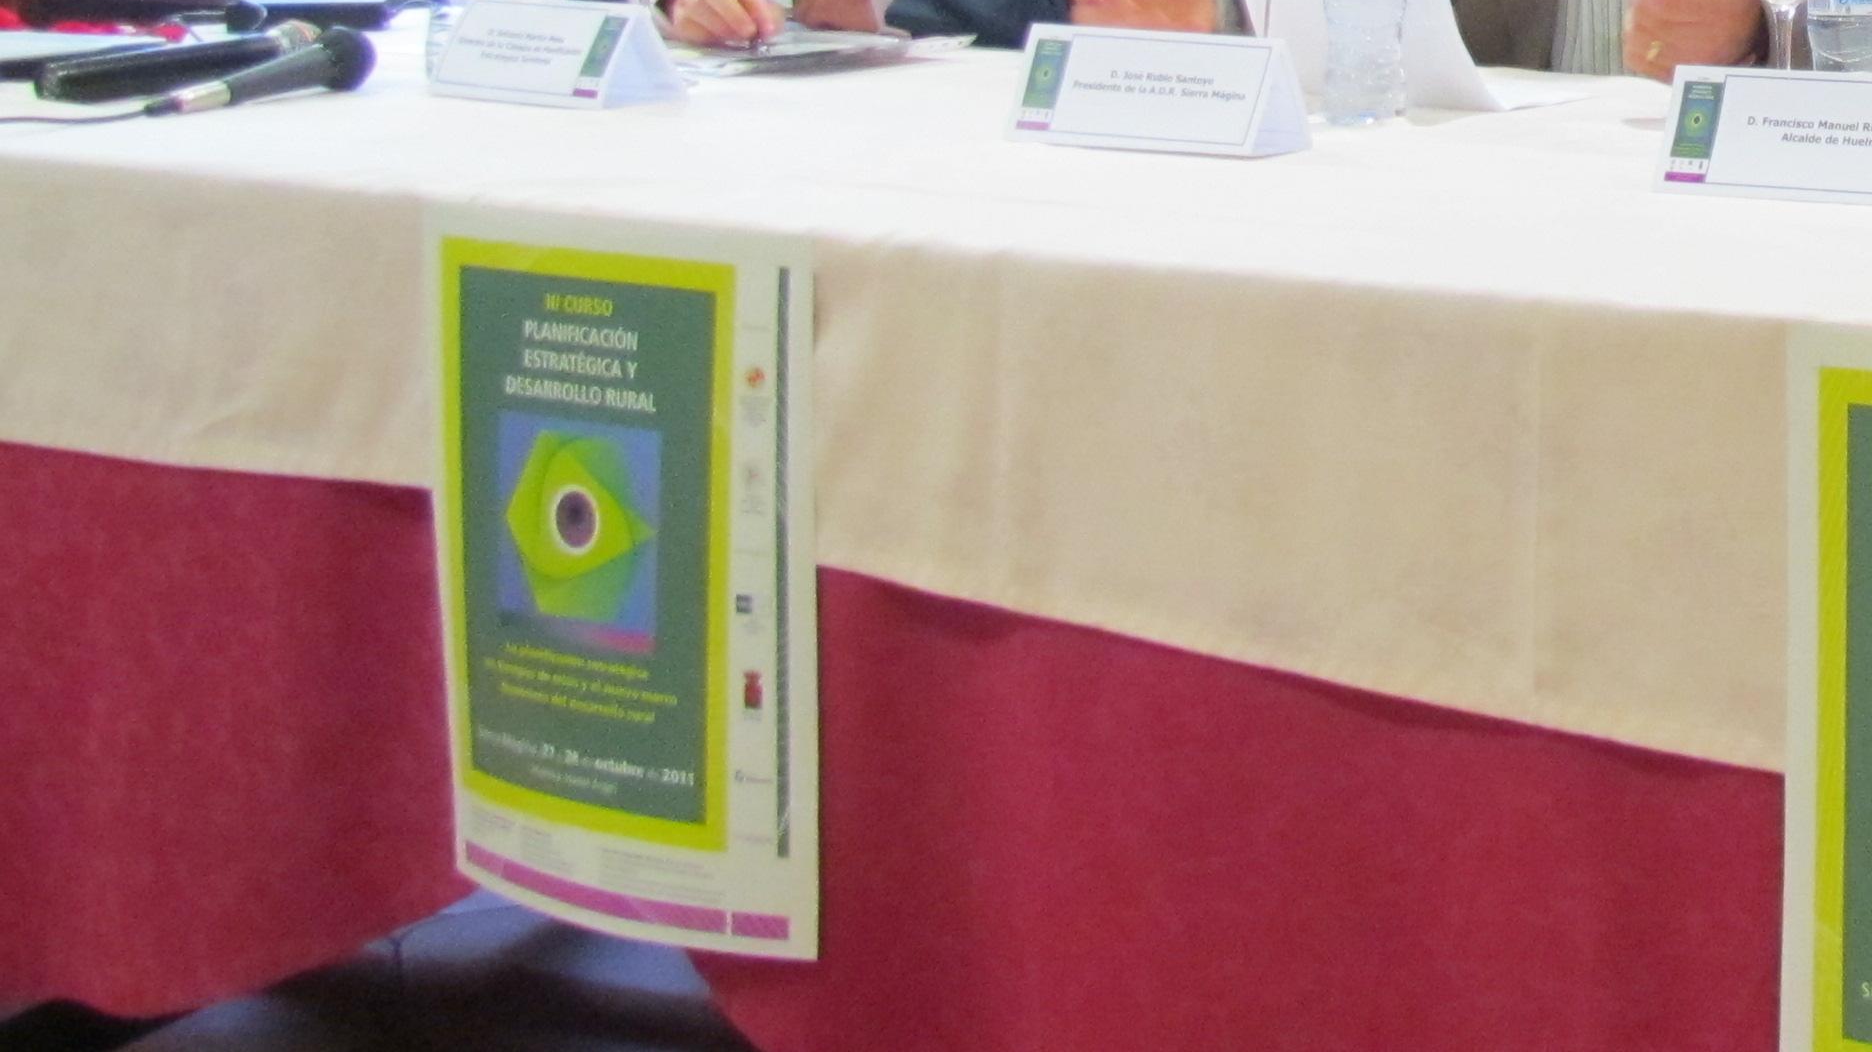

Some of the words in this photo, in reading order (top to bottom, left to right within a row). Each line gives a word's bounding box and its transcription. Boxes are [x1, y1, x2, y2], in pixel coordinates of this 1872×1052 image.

[1073, 79, 1121, 92] Presidente
[1124, 83, 1136, 93] de
[1138, 84, 1147, 94] la
[1181, 87, 1208, 98] Sierra
[1747, 115, 1758, 126] D.
[1762, 116, 1815, 130] Francisco
[1818, 119, 1859, 132] Manuel
[1781, 133, 1822, 145] Alcalde
[1825, 134, 1839, 145] de
[563, 294, 613, 317] CURSO
[523, 319, 638, 351] PLANIFICACIÓN
[523, 348, 623, 378] ESTRATÉGICA
[627, 361, 638, 379] Y
[505, 375, 601, 405] DESARROLLO
[605, 388, 656, 413] RURAL
